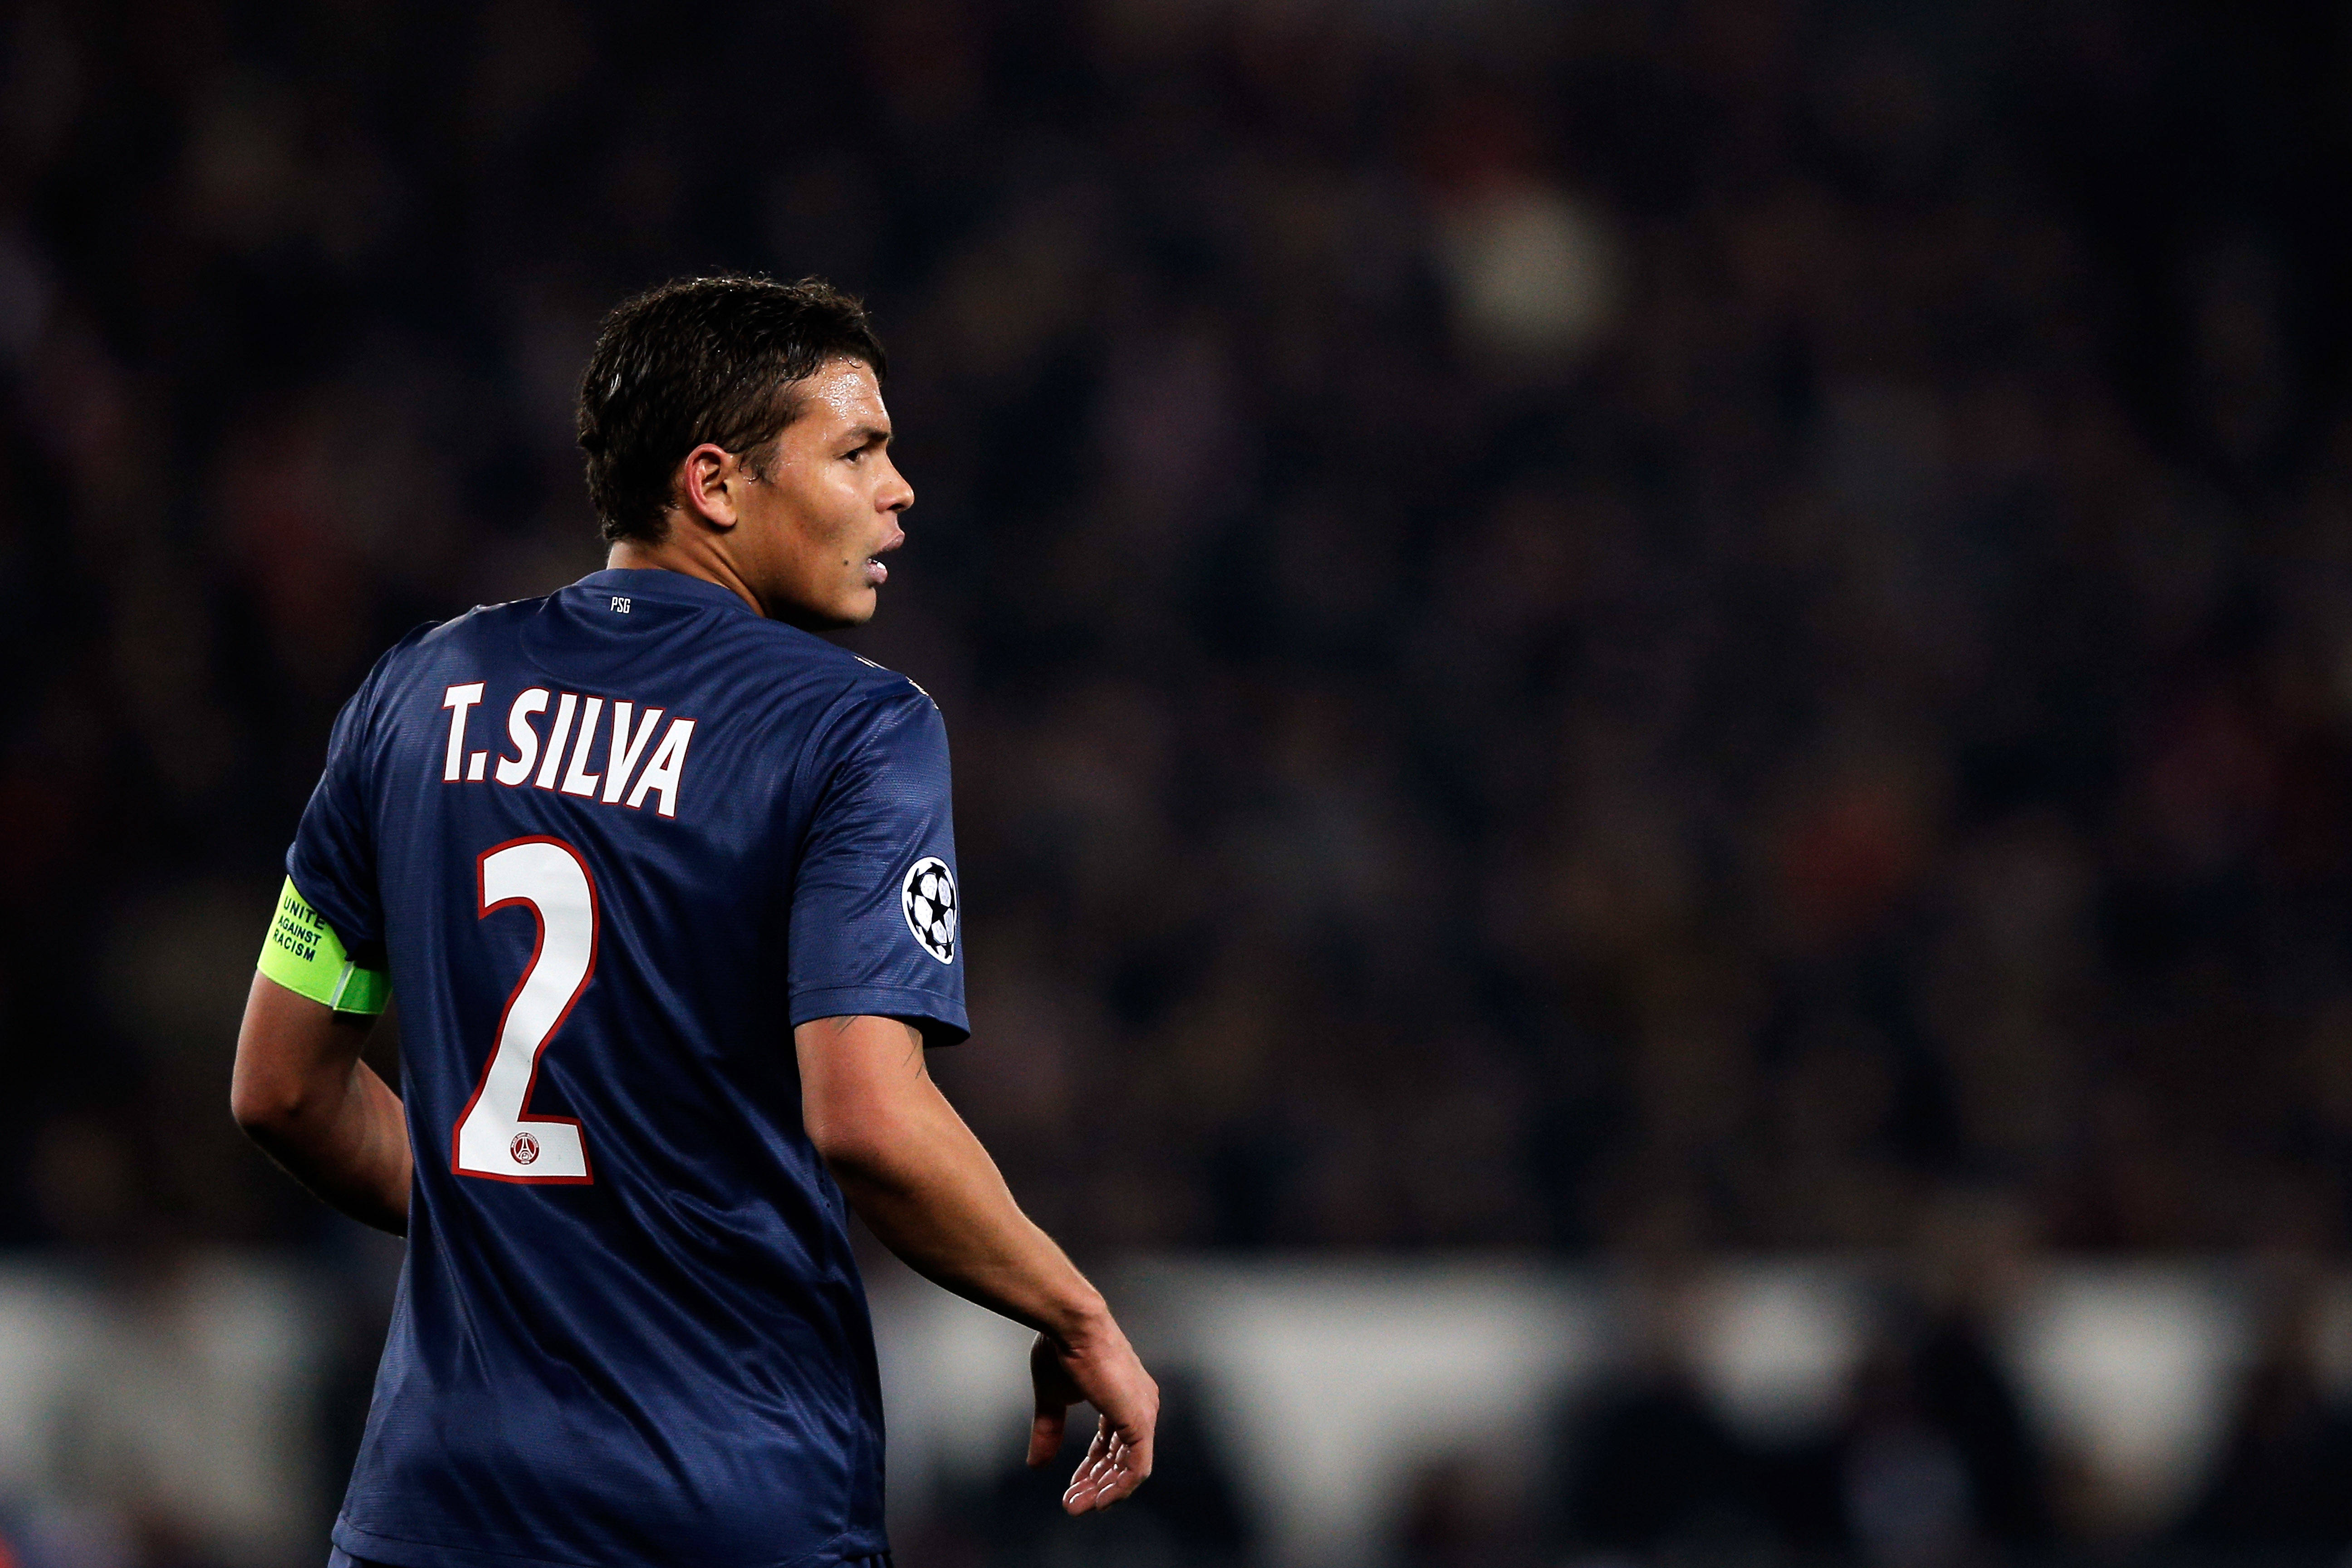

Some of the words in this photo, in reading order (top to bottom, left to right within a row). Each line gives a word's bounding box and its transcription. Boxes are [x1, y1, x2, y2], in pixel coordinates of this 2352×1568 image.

[610, 596, 631, 614] PSG
[284, 895, 326, 931] UNITE
[273, 929, 316, 962] RACISM
[278, 915, 322, 946] AGAINST
[451, 835, 599, 1185] 2
